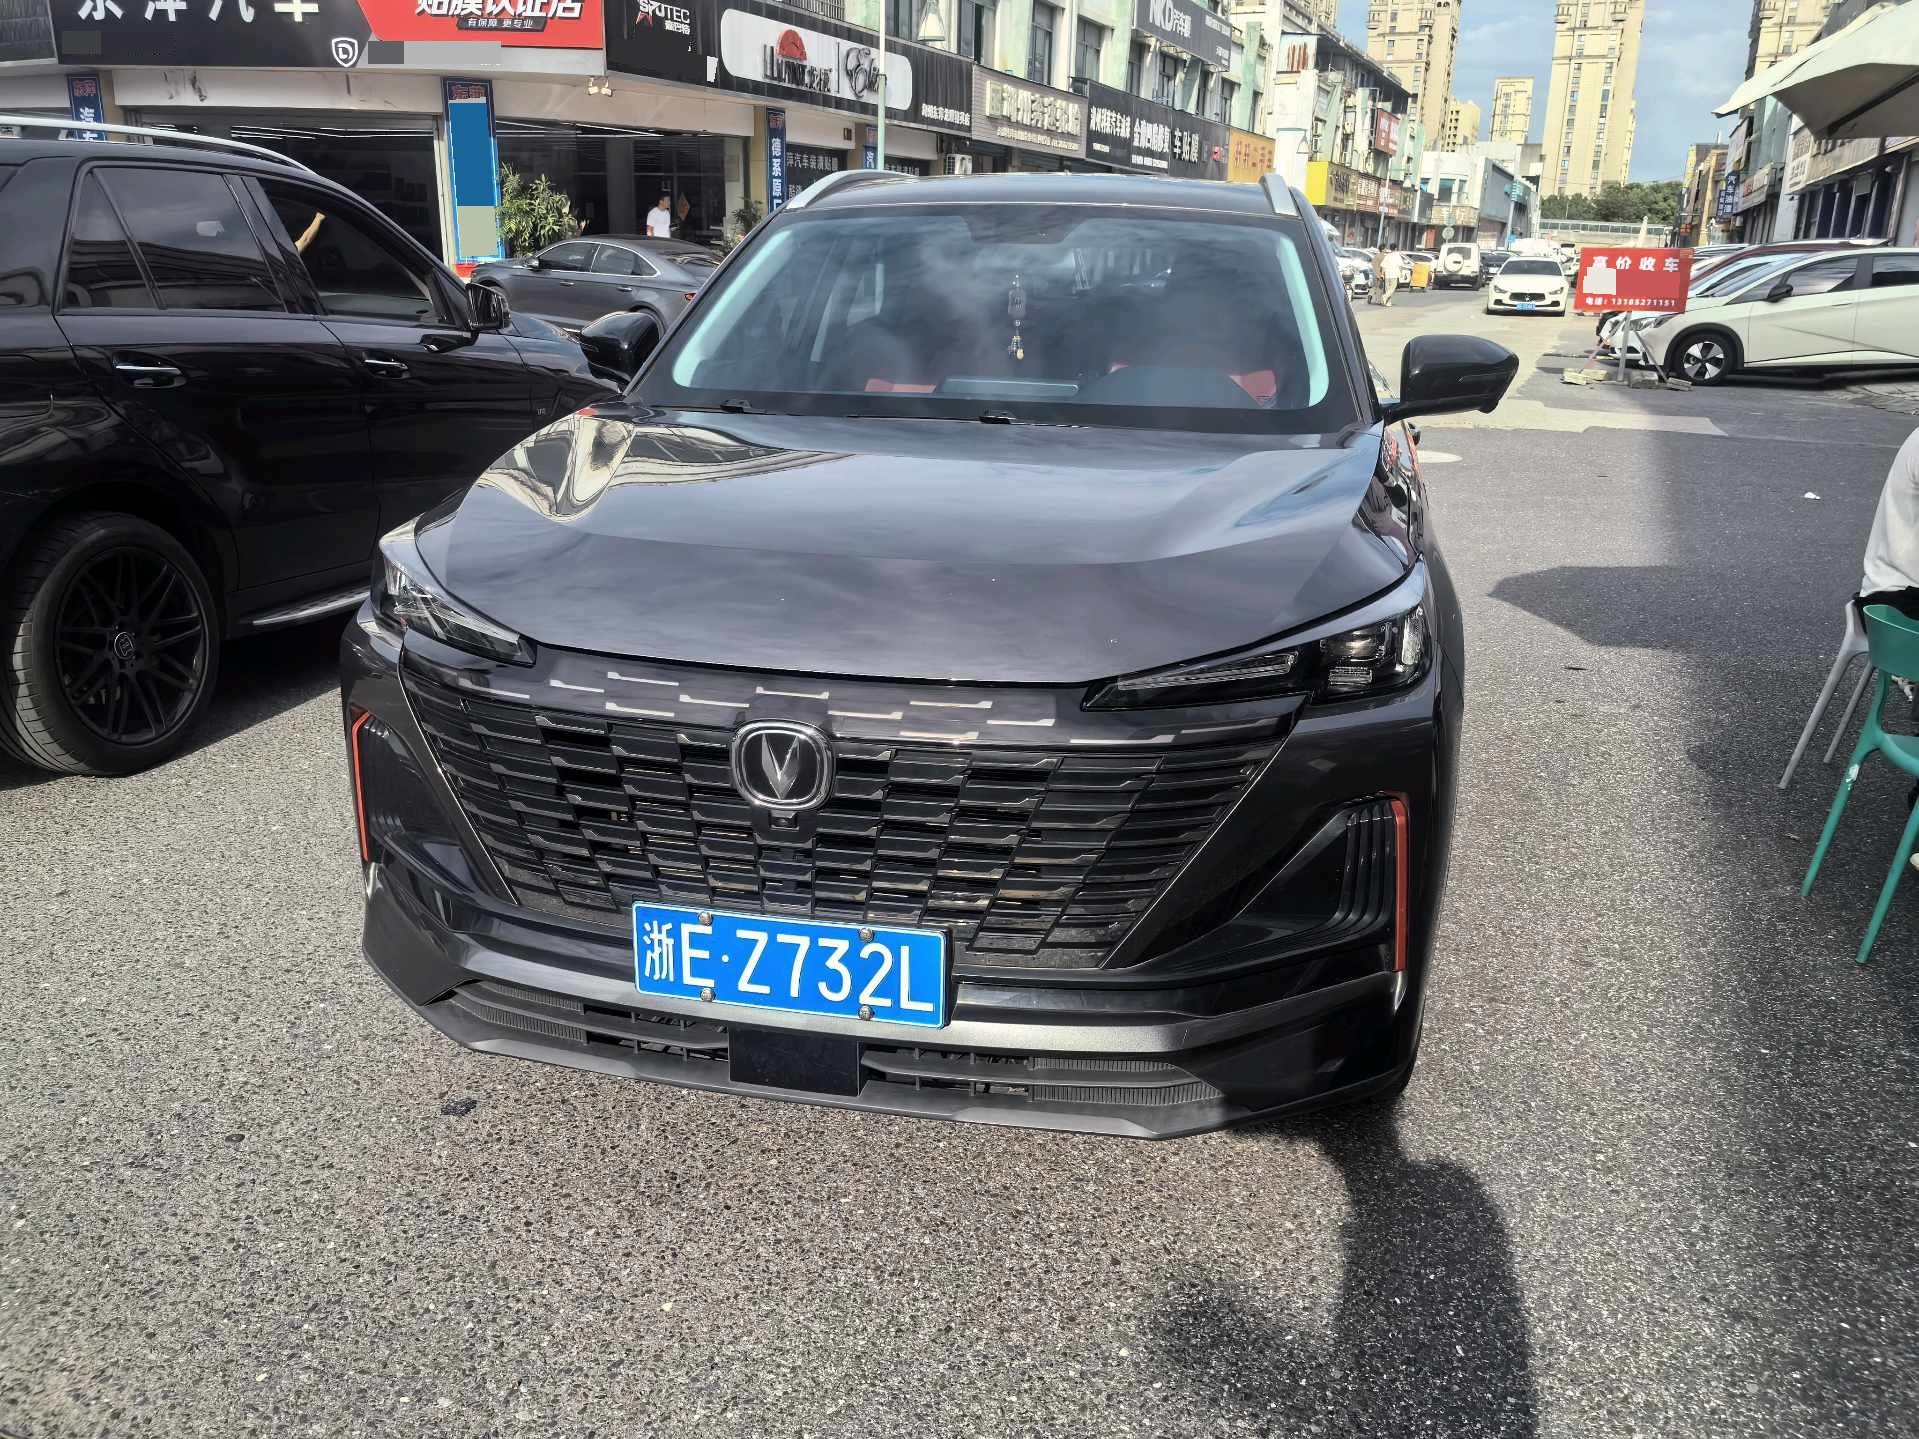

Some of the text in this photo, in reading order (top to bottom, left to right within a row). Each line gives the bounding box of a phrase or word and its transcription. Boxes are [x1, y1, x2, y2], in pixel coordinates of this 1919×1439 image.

[468, 18, 534, 29] 有保障 更专业
[1592, 256, 1680, 272] 高价收车
